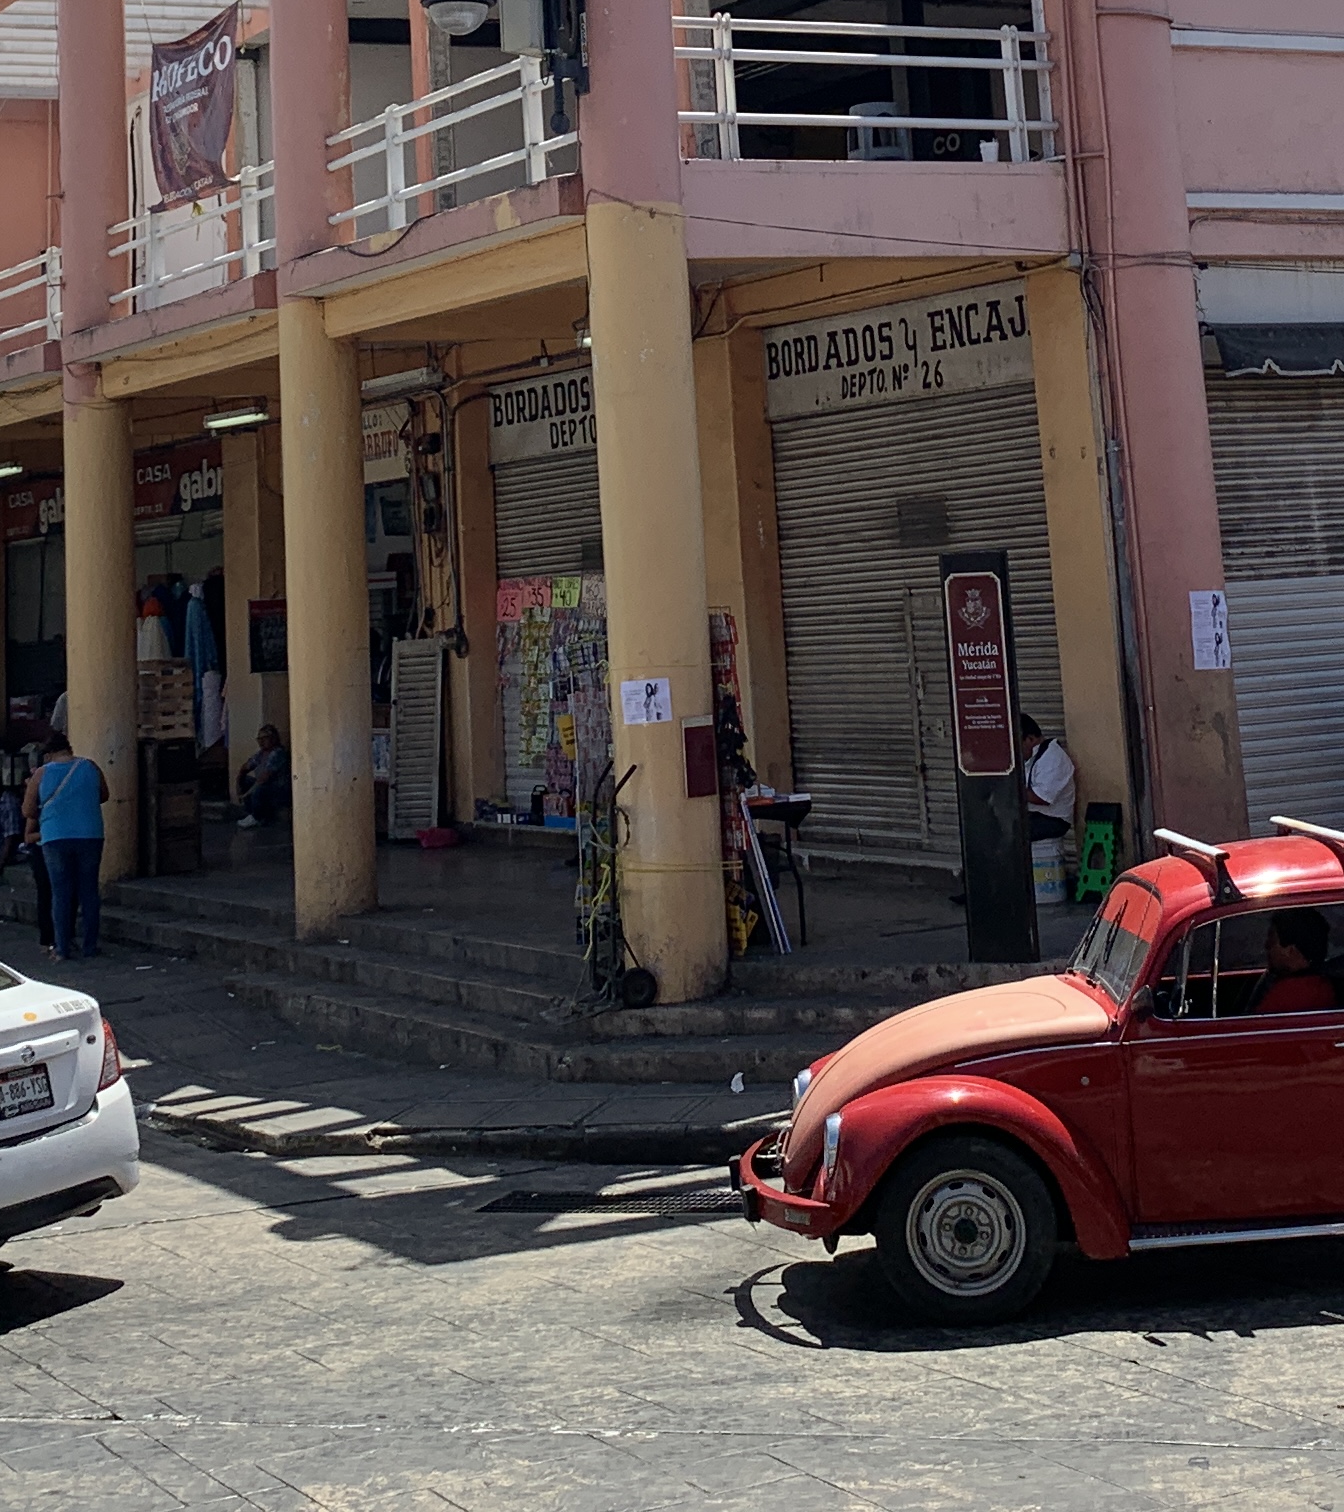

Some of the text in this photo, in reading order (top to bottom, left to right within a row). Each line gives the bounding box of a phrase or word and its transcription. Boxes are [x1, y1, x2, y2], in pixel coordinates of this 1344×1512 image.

[766, 322, 893, 380] BORDADOS
[927, 294, 1031, 352] ENCAJ
[841, 366, 887, 400] DEPTO.
[921, 359, 944, 389] 26
[493, 375, 591, 428] BORDADOS
[549, 413, 597, 449] DEPTO
[136, 463, 172, 485] CASA
[8, 491, 35, 509] CASA
[958, 641, 999, 657] Mérida
[961, 659, 997, 672] Yucatán
